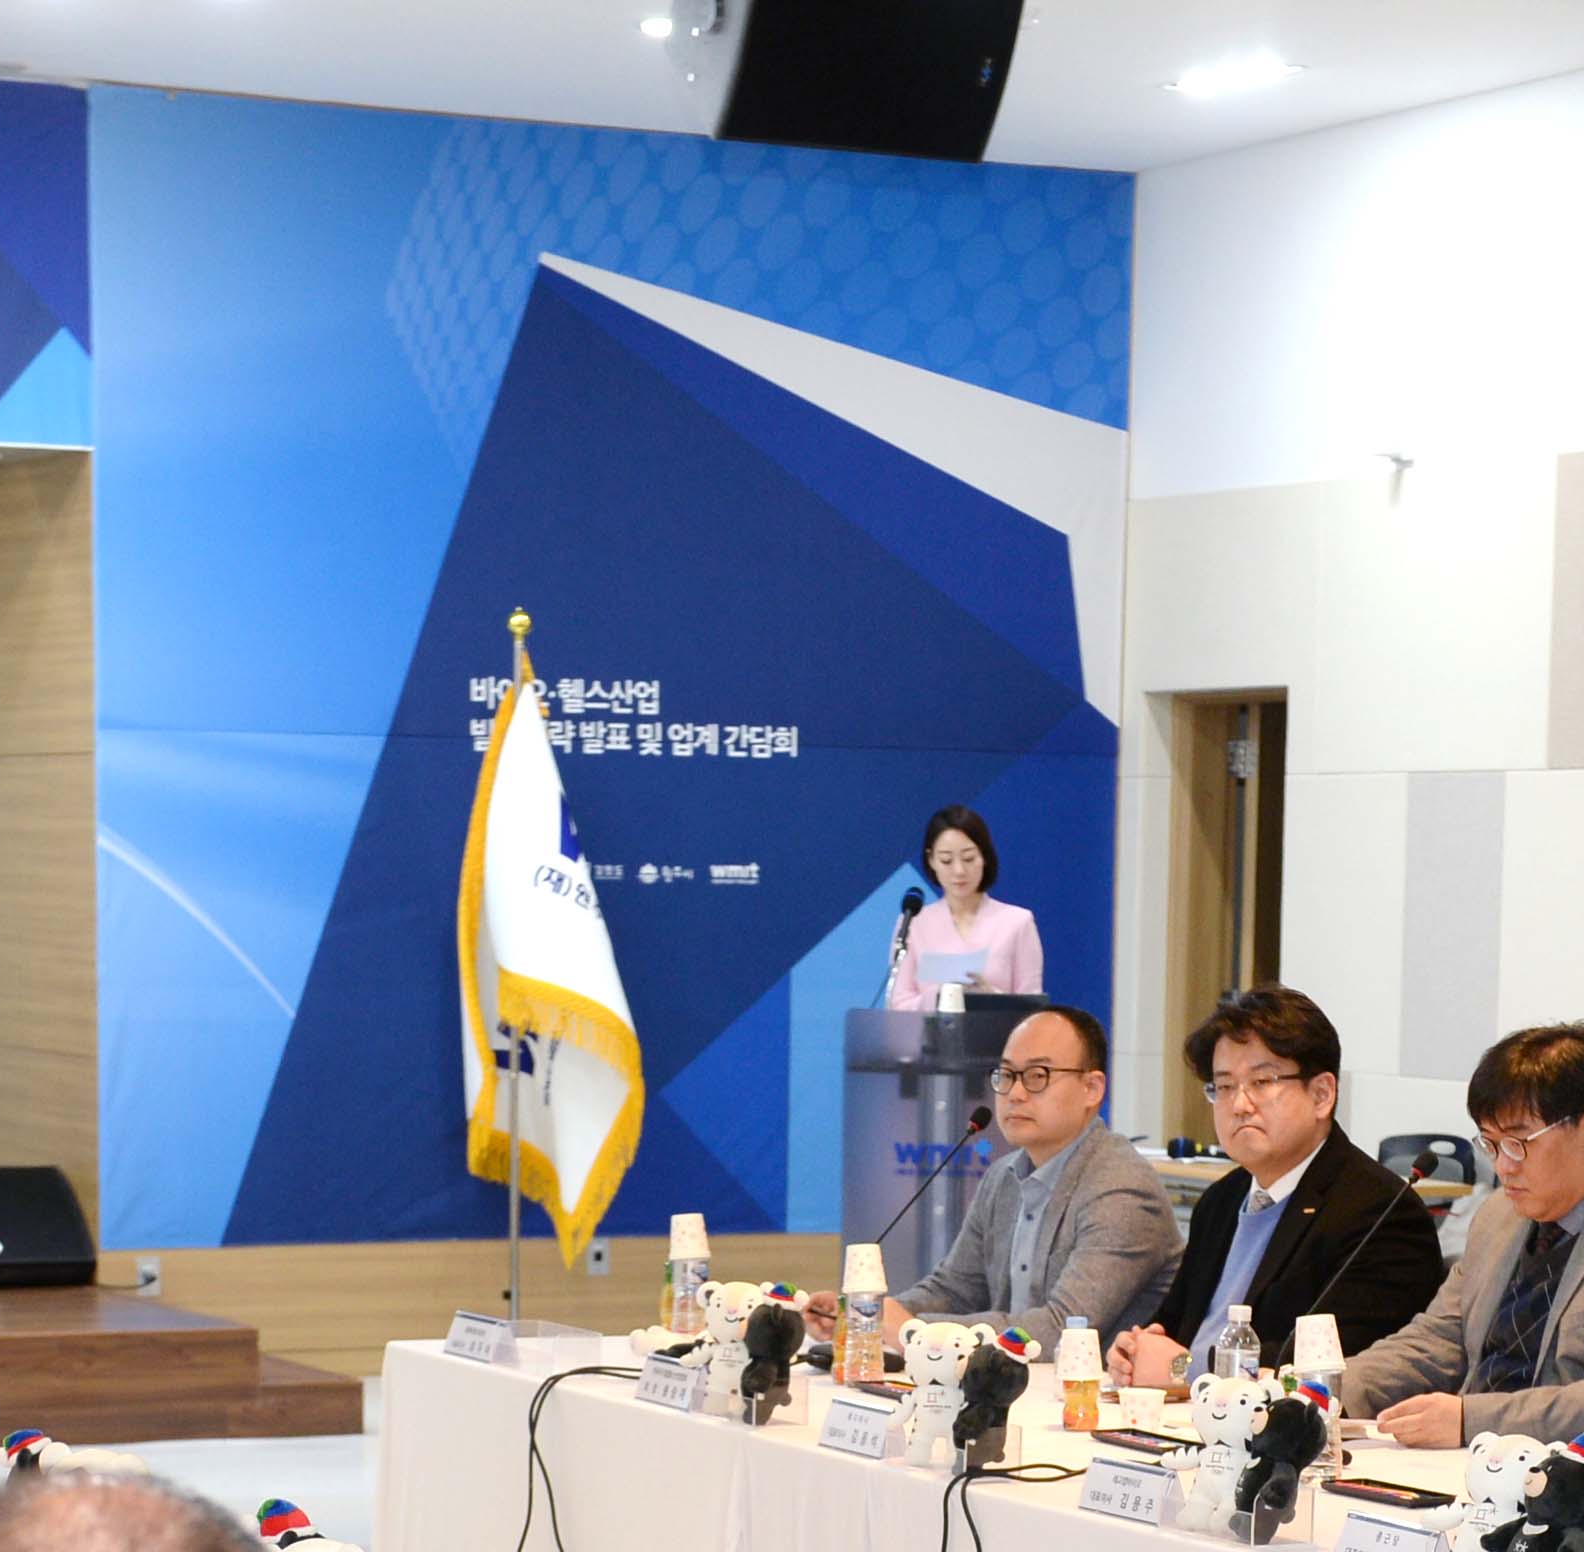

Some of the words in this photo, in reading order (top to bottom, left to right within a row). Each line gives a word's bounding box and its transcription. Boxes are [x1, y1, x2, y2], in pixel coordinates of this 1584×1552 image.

[578, 720, 632, 754] 발표
[636, 722, 663, 756] 및
[667, 723, 719, 757] 업계
[723, 724, 798, 758] 간담회
